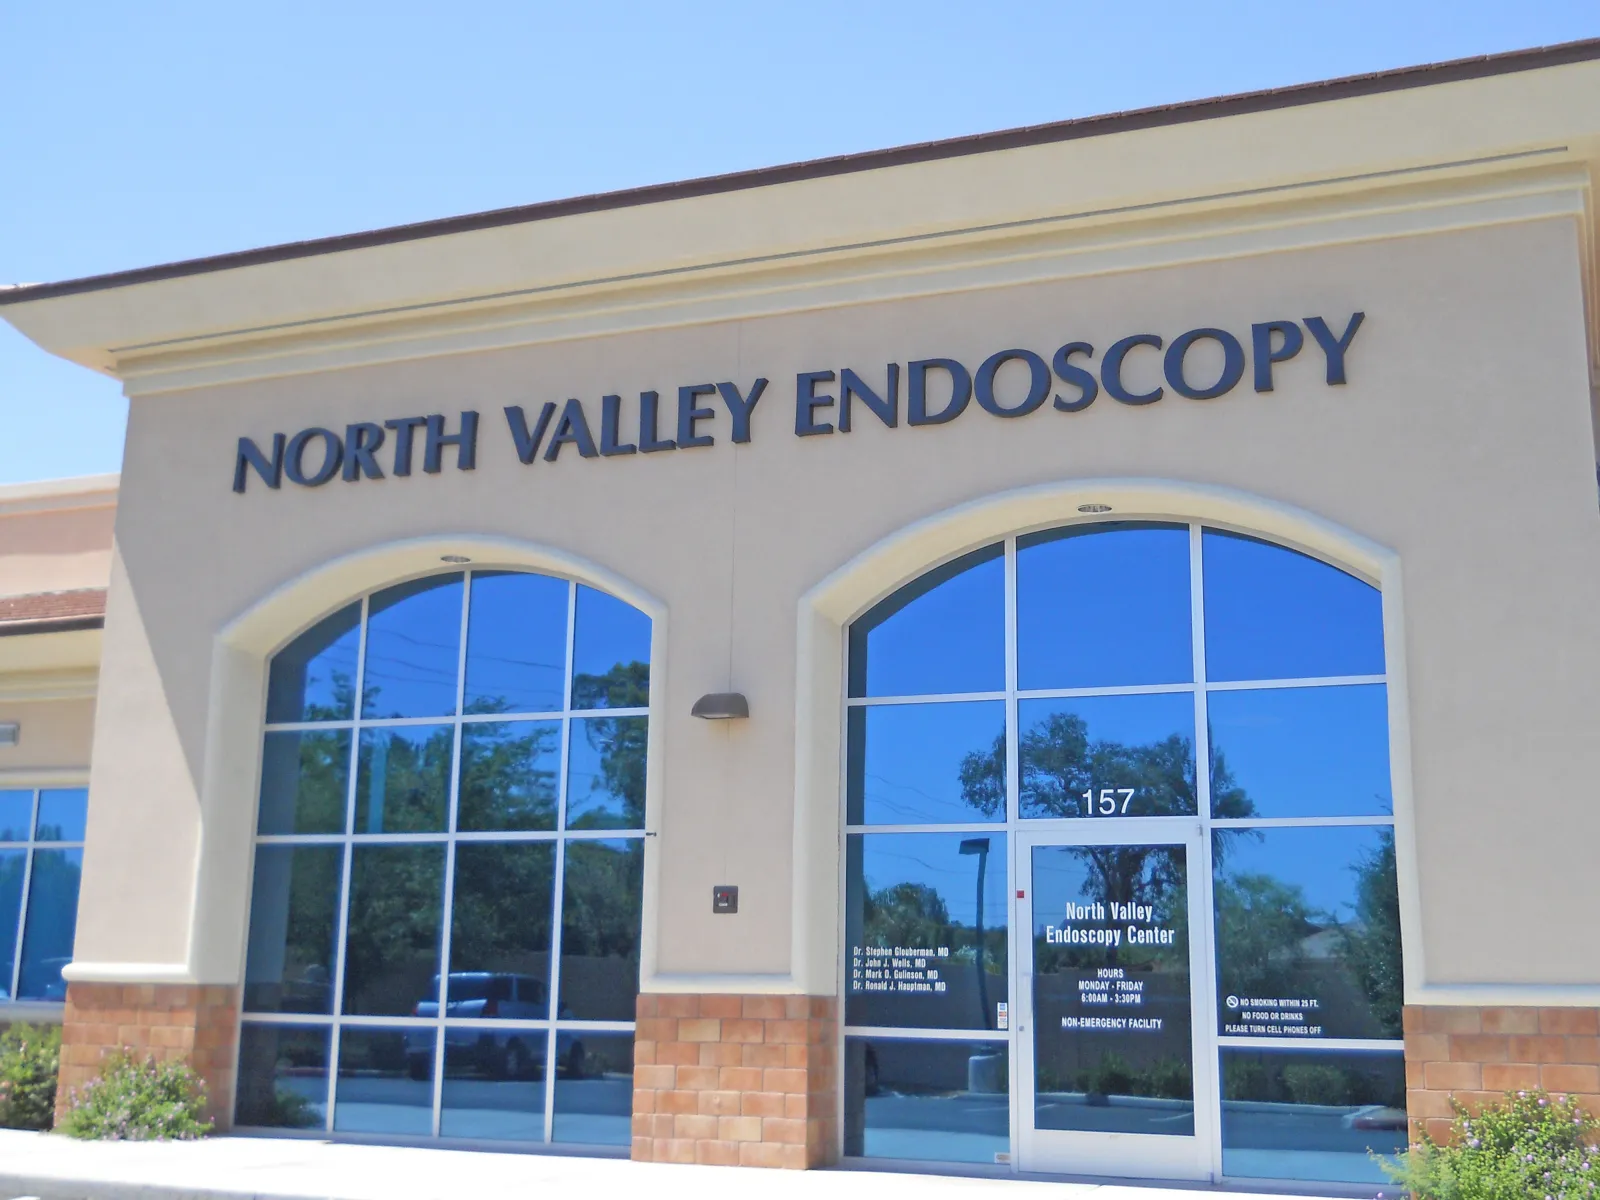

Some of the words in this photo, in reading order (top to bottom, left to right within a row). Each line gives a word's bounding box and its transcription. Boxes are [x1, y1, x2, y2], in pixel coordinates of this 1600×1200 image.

[232, 410, 480, 494] NORTH
[503, 377, 769, 465] VALLEY
[794, 311, 1365, 437] ENDOSCOPY
[1082, 788, 1135, 815] 157
[1066, 902, 1104, 920] North
[1110, 902, 1152, 922] Valley
[1046, 926, 1121, 946] Endoscopy
[1128, 926, 1175, 943] Center
[853, 946, 863, 956] Dr.
[865, 946, 892, 957] Stephen
[937, 947, 949, 957] MD
[853, 958, 863, 967] Dr.
[865, 958, 881, 967] John
[883, 958, 889, 967] J.
[892, 959, 912, 968] Wells,
[915, 959, 926, 968] MD
[853, 969, 863, 978] Dr.
[865, 969, 882, 979] Mark
[894, 970, 924, 980] Gulinson,
[927, 970, 938, 980] MD
[1098, 969, 1124, 978] HOURS
[853, 981, 863, 990] Dr.
[865, 981, 887, 990] Ronald
[889, 981, 896, 991] J.
[898, 981, 933, 992] Hauptman,
[935, 982, 946, 991] MD
[1078, 981, 1110, 990] MONDAY
[1116, 981, 1143, 991] FRIDAY
[1082, 993, 1107, 1002] 6:00AM
[1115, 994, 1141, 1003] 3:30PM
[1250, 999, 1278, 1007] SMOKING
[1252, 1012, 1268, 1020] FOOD
[1062, 1017, 1126, 1028] NON-EMERGENCY
[1129, 1018, 1162, 1029] FACILITY
[1225, 1024, 1248, 1032] PLEASE
[1249, 1025, 1265, 1033] TURN
[1284, 1026, 1308, 1034] PHONES
[1309, 1026, 1321, 1034] OFF
